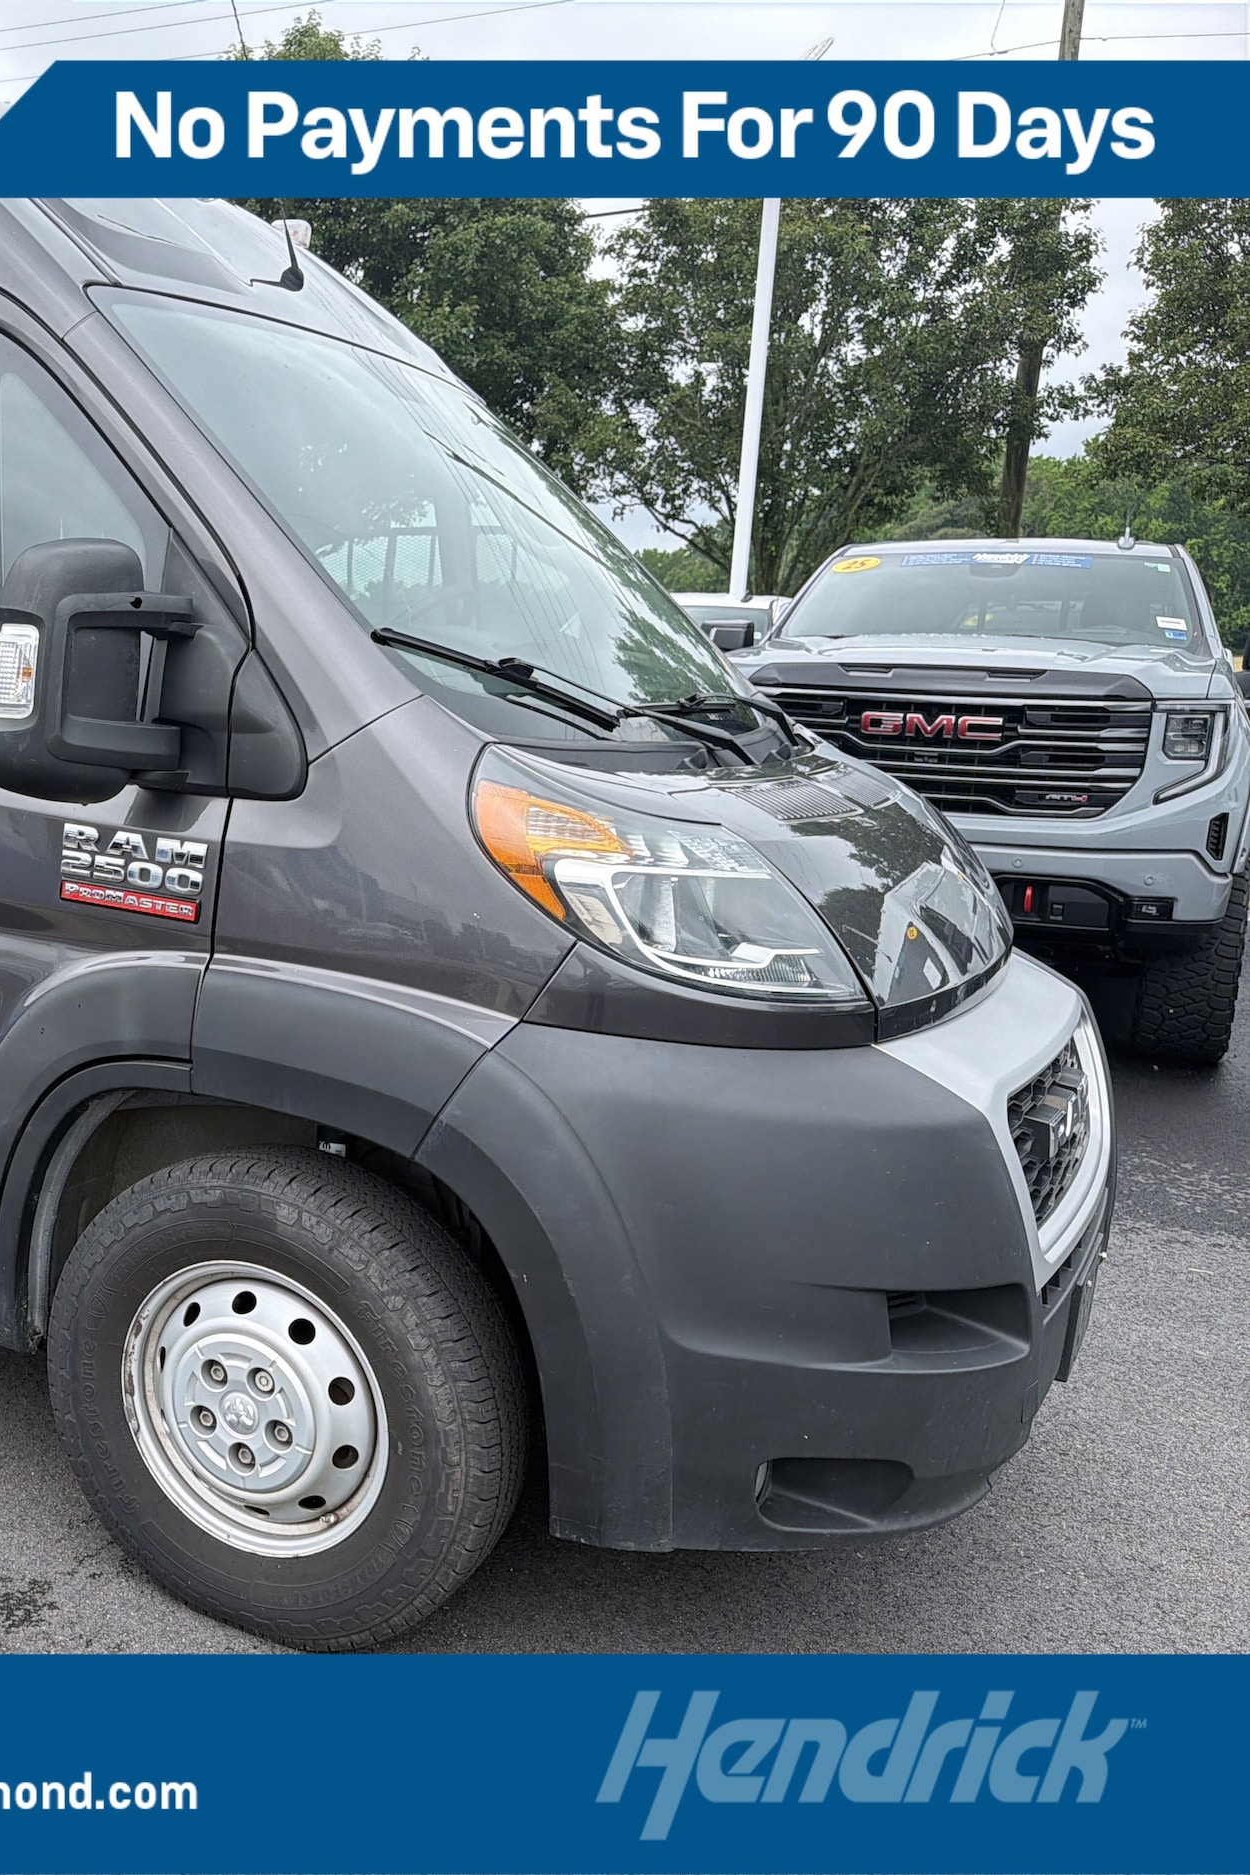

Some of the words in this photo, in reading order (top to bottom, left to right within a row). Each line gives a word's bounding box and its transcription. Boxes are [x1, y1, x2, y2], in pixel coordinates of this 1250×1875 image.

[861, 710, 1004, 741] GMC
[63, 822, 209, 869] RAM
[60, 849, 204, 896] 2500
[355, 1300, 425, 1497] Firestone
[80, 1338, 139, 1514] Firestone
